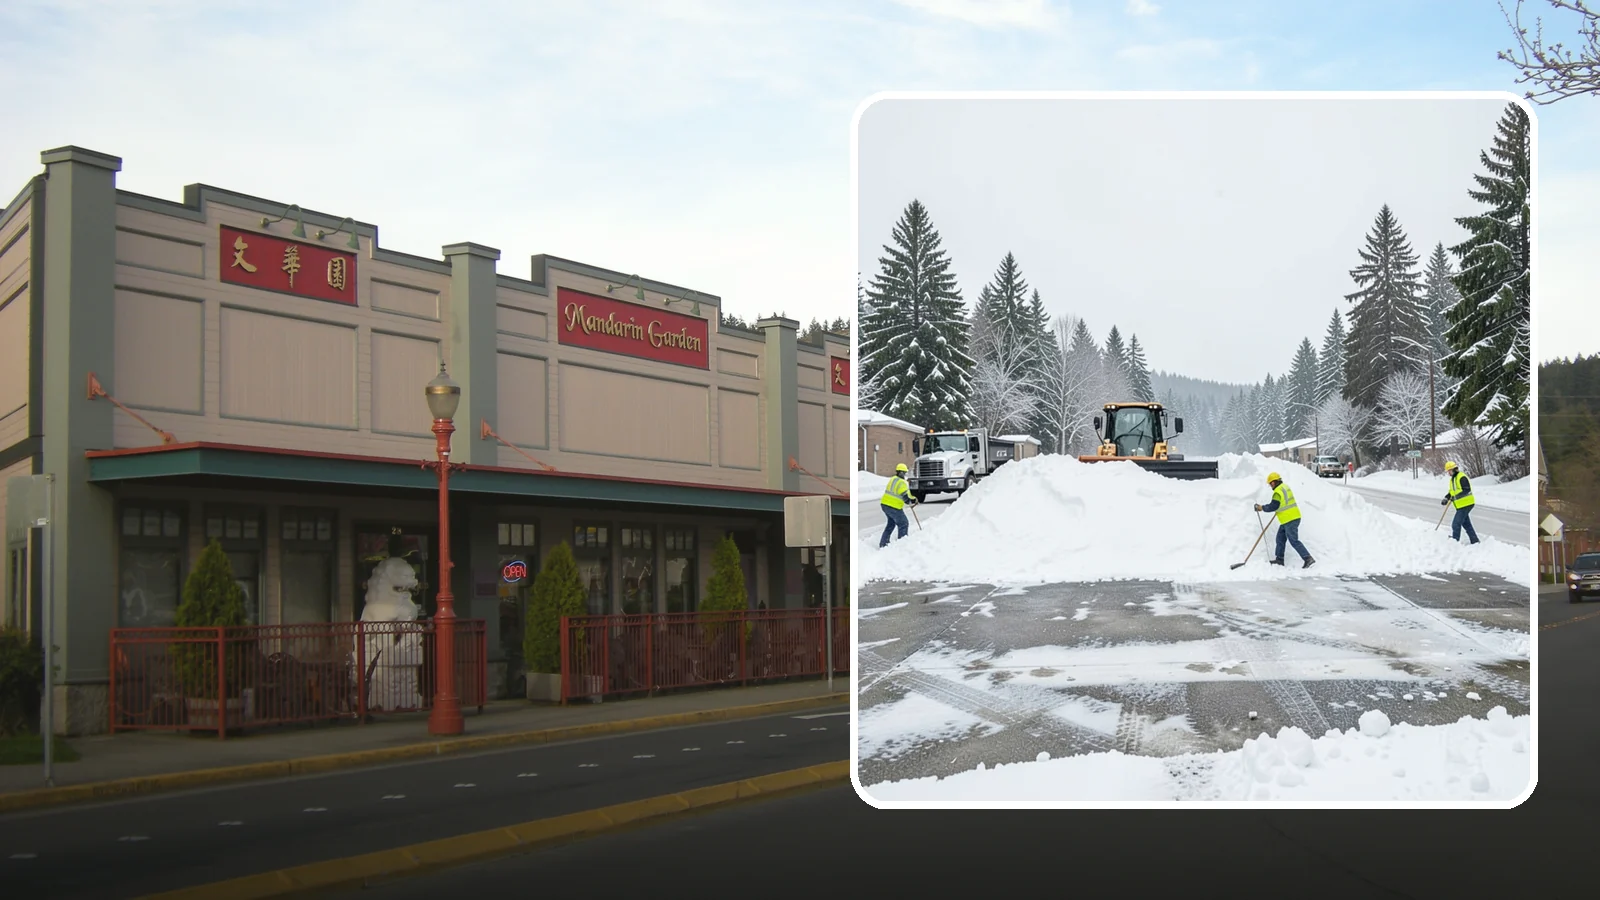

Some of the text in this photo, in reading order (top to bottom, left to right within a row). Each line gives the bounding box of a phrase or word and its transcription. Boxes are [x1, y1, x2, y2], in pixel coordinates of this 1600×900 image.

[231, 235, 346, 291] 文華園
[564, 302, 701, 352] Mandarin Garden
[503, 565, 526, 578] OPEN
